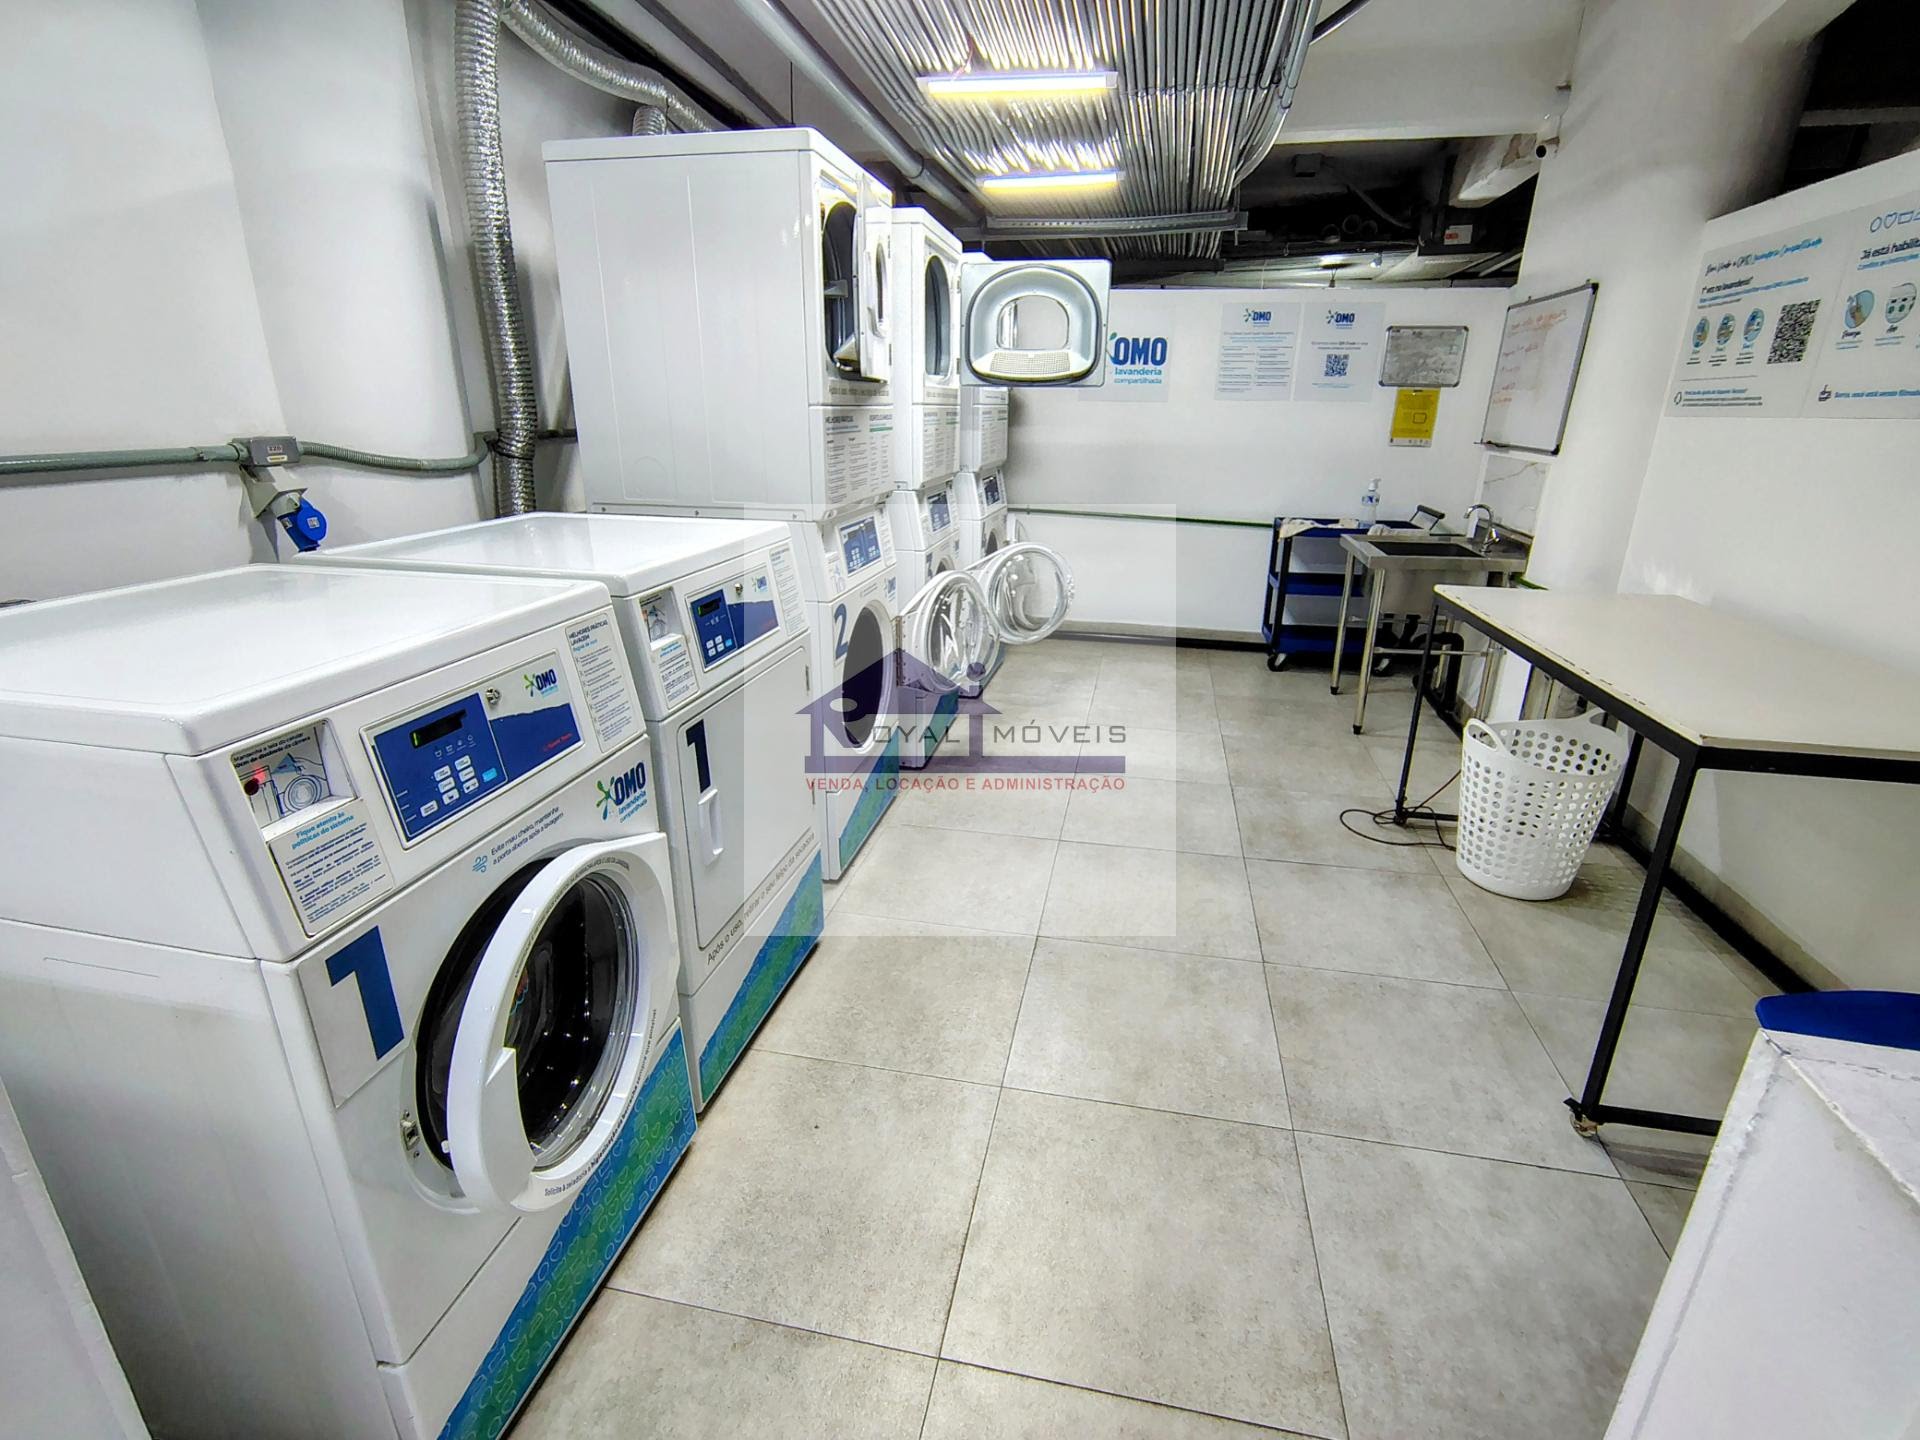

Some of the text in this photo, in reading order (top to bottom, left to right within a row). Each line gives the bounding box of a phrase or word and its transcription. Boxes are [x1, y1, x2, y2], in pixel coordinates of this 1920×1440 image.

[1252, 310, 1272, 322] OMO
[1335, 312, 1355, 323] OMO
[1113, 336, 1168, 366] OMO
[1115, 367, 1162, 376] lavanderia
[833, 603, 849, 660] 2
[535, 668, 557, 692] OMO
[685, 719, 712, 794] 1
[613, 762, 647, 806] OMO
[296, 825, 316, 839] Fique
[491, 843, 505, 856] Evite
[324, 924, 405, 1061] 1
